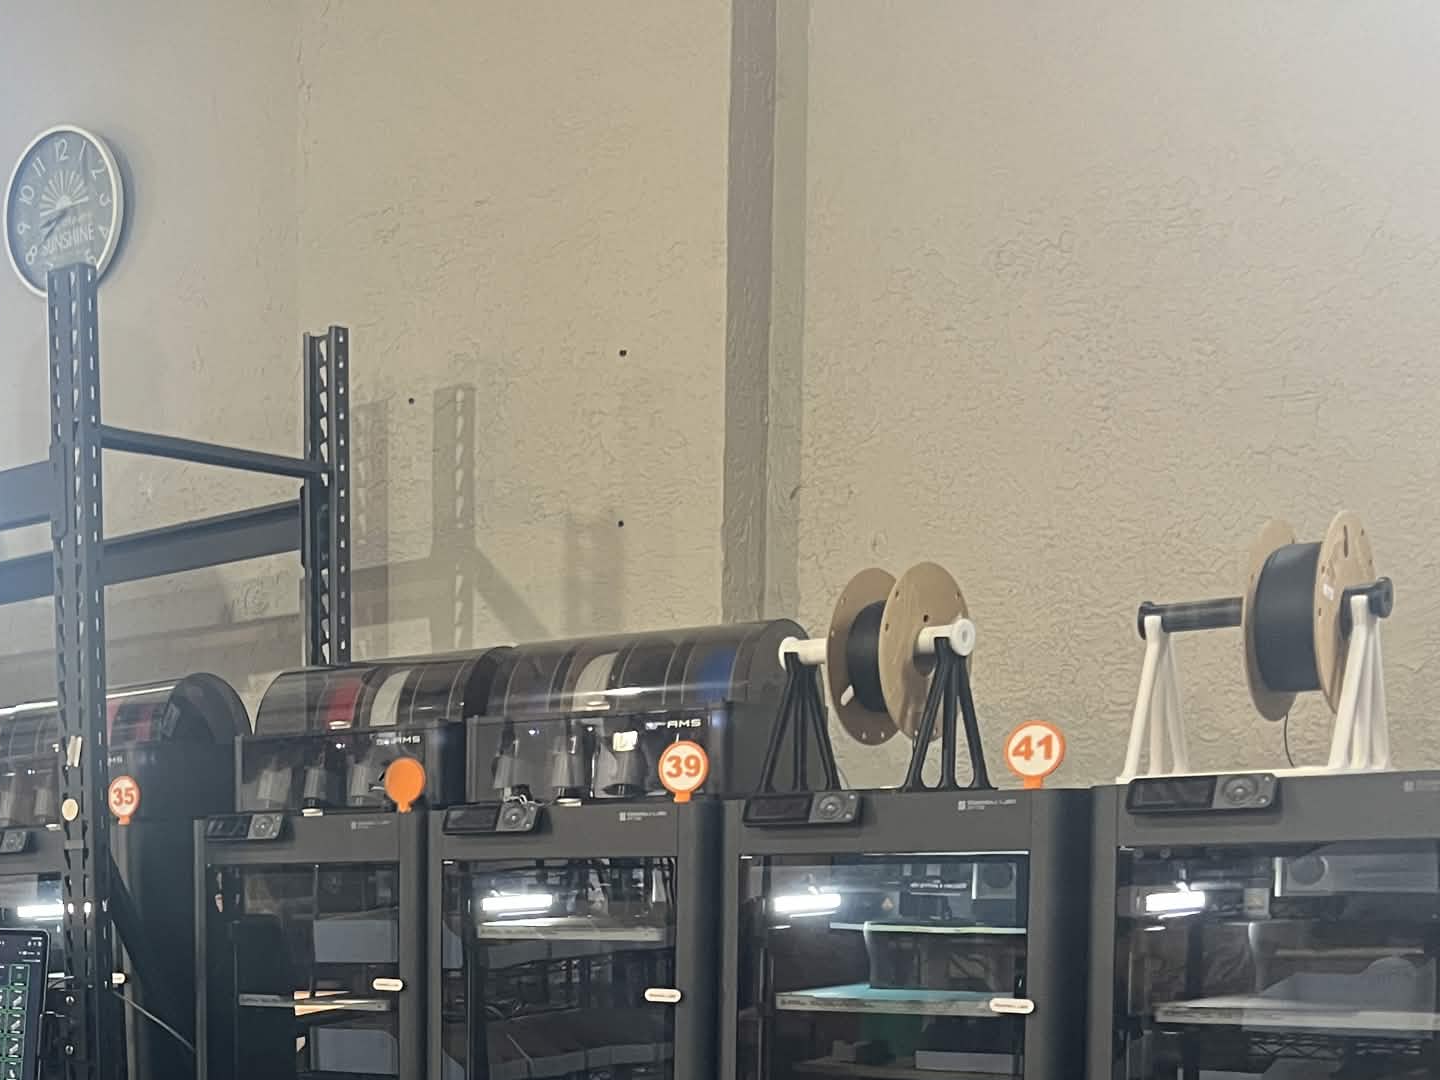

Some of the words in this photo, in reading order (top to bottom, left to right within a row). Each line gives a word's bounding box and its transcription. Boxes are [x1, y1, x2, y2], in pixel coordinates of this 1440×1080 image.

[54, 138, 69, 162] 12
[32, 156, 46, 177] 11
[18, 184, 35, 206] 10
[16, 220, 32, 235] 9
[24, 244, 38, 265] 8
[667, 718, 702, 729] AMS
[1011, 733, 1055, 762] 41
[665, 754, 702, 779] 39
[112, 786, 136, 807] 35
